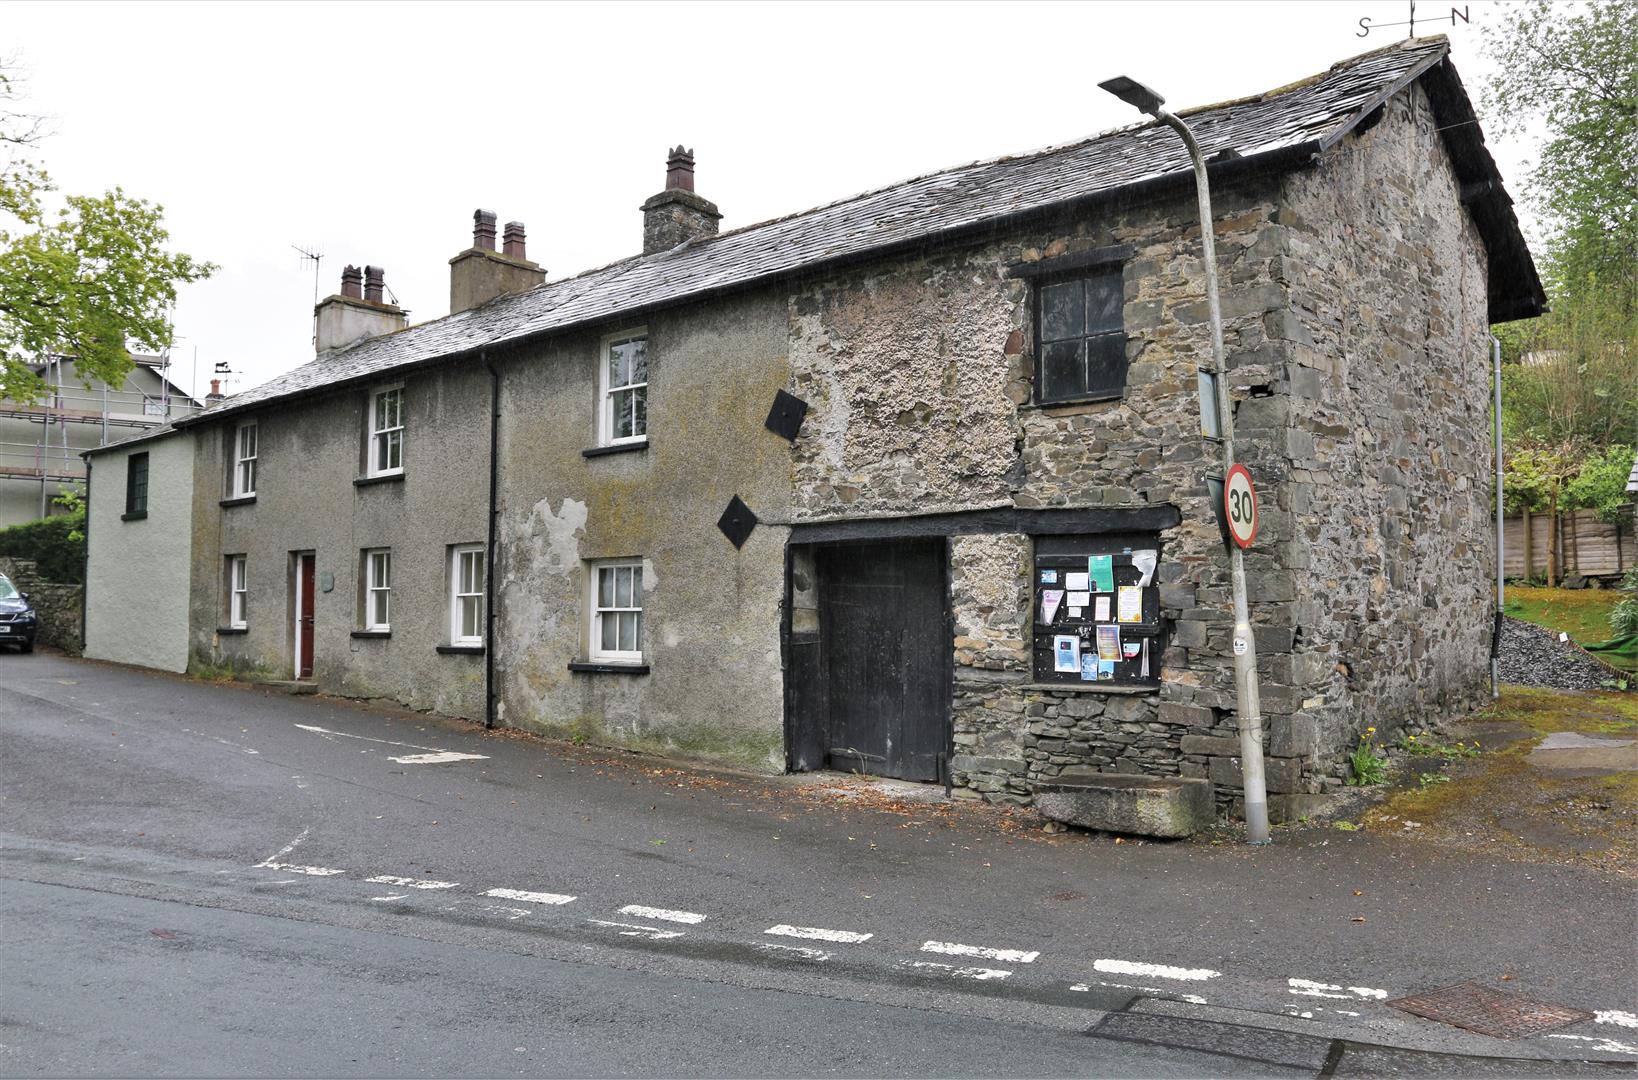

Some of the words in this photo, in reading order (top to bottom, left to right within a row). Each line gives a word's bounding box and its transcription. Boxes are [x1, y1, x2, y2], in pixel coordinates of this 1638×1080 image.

[1451, 5, 1469, 26] N
[1356, 17, 1371, 37] S
[1230, 489, 1253, 525] 30
